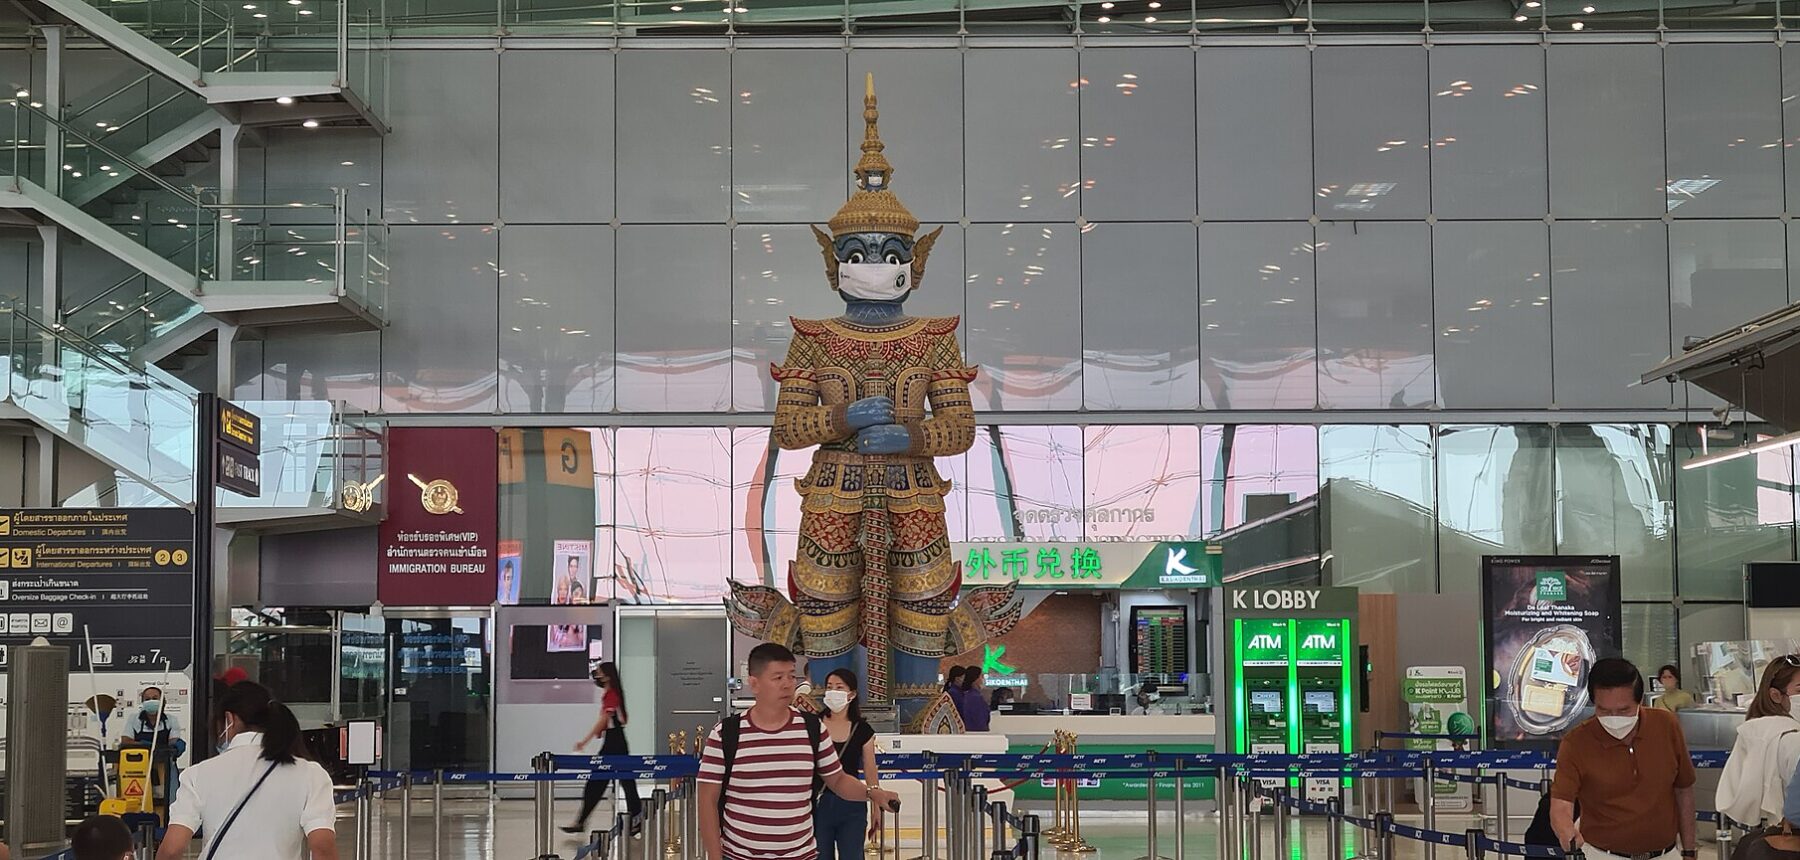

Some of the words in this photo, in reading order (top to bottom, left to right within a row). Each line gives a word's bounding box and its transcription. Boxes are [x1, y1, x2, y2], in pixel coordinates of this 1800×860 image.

[13, 511, 128, 525] ผู้โดยสารขาออกภายในประเทศ
[48, 529, 86, 537] Departures
[160, 554, 166, 562] 2
[177, 554, 183, 562] 3
[387, 546, 487, 557] สำนักงานตรวจคนเข้าเมือง
[77, 561, 112, 569] Departures
[389, 564, 446, 573] IMMIGRATION
[450, 564, 486, 573] BUREAU
[965, 547, 1102, 580] 外币兑换
[1166, 547, 1199, 576] K
[41, 594, 68, 602] Baggage
[1233, 590, 1247, 609] K
[1254, 589, 1321, 609] LOBBY
[1248, 635, 1282, 649] ATM
[1302, 635, 1335, 649] ATM
[982, 644, 1016, 675] K
